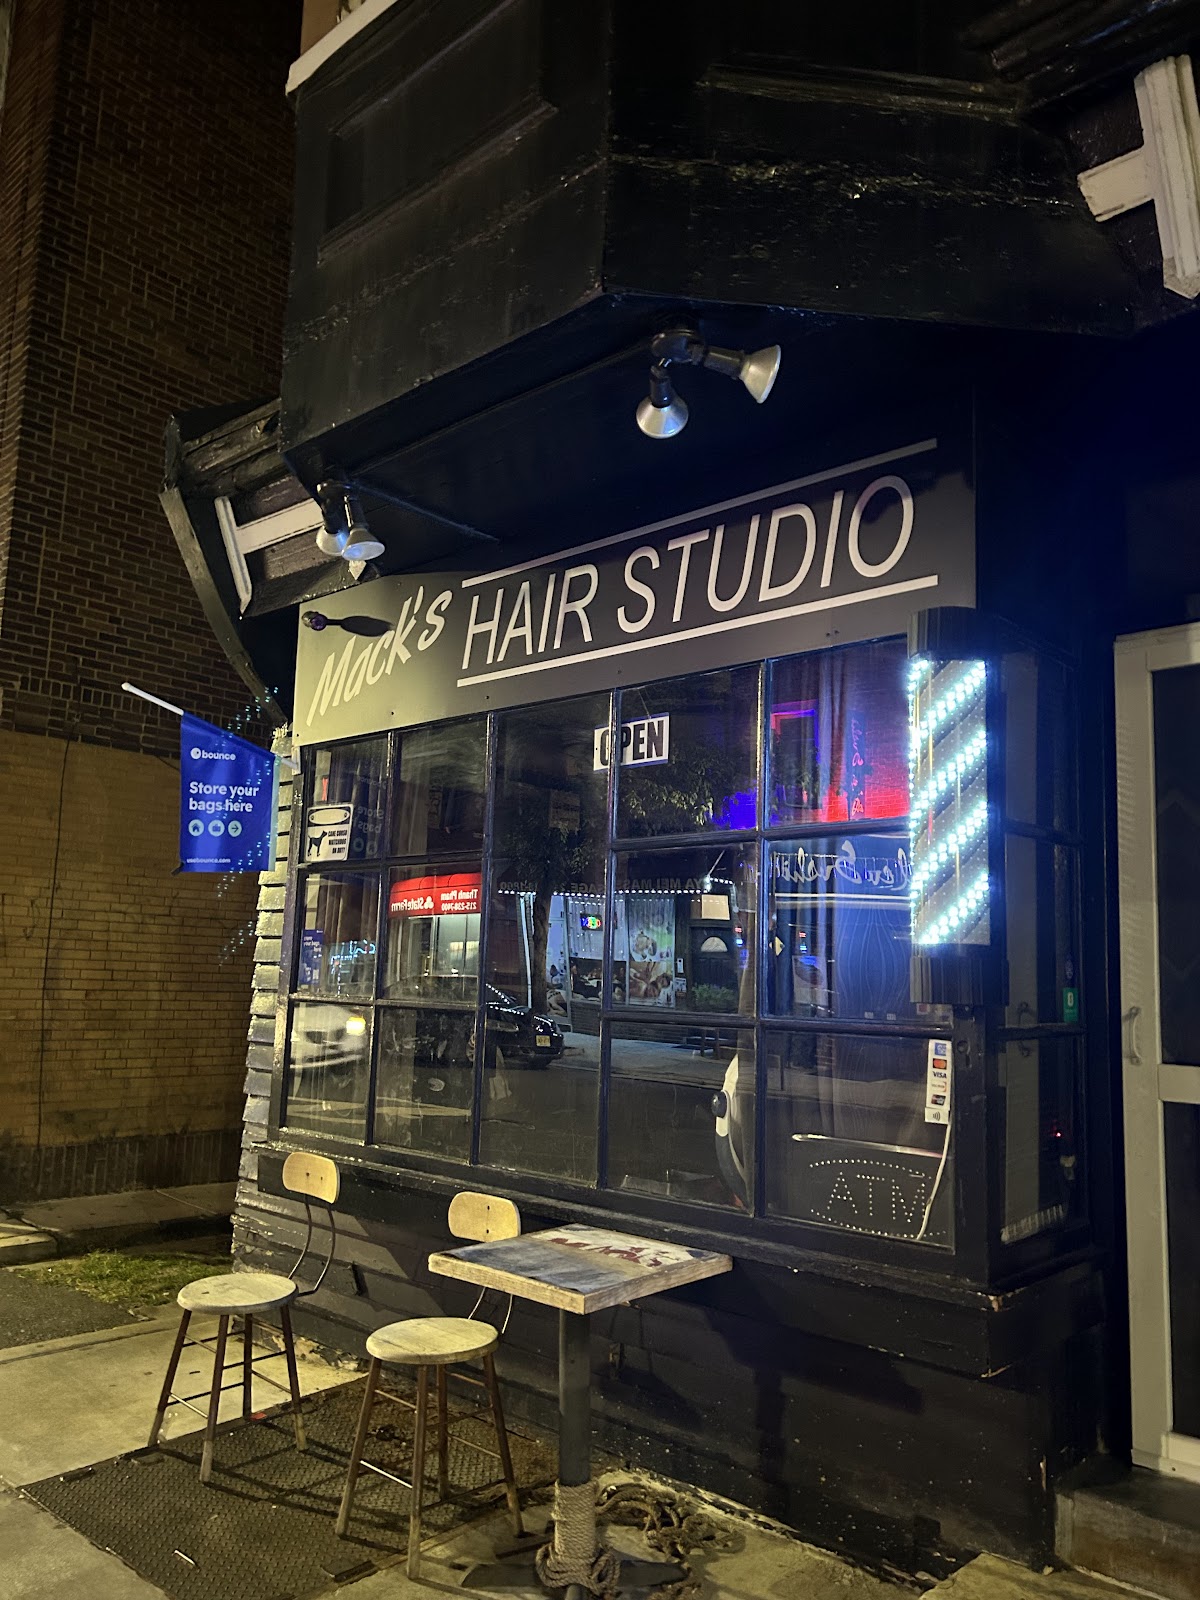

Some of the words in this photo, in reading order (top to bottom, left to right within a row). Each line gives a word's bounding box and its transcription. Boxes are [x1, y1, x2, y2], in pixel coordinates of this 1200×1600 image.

[305, 584, 453, 727] Mack's
[461, 563, 599, 669] HAIR
[616, 475, 915, 635] STUDIO
[600, 719, 665, 767] OPEN
[201, 749, 236, 761] bounce
[189, 781, 227, 796] Store
[230, 785, 260, 798] your
[189, 798, 222, 815] bags
[225, 799, 253, 813] here
[932, 1071, 947, 1079] VISA
[827, 1171, 926, 1224] ATM
